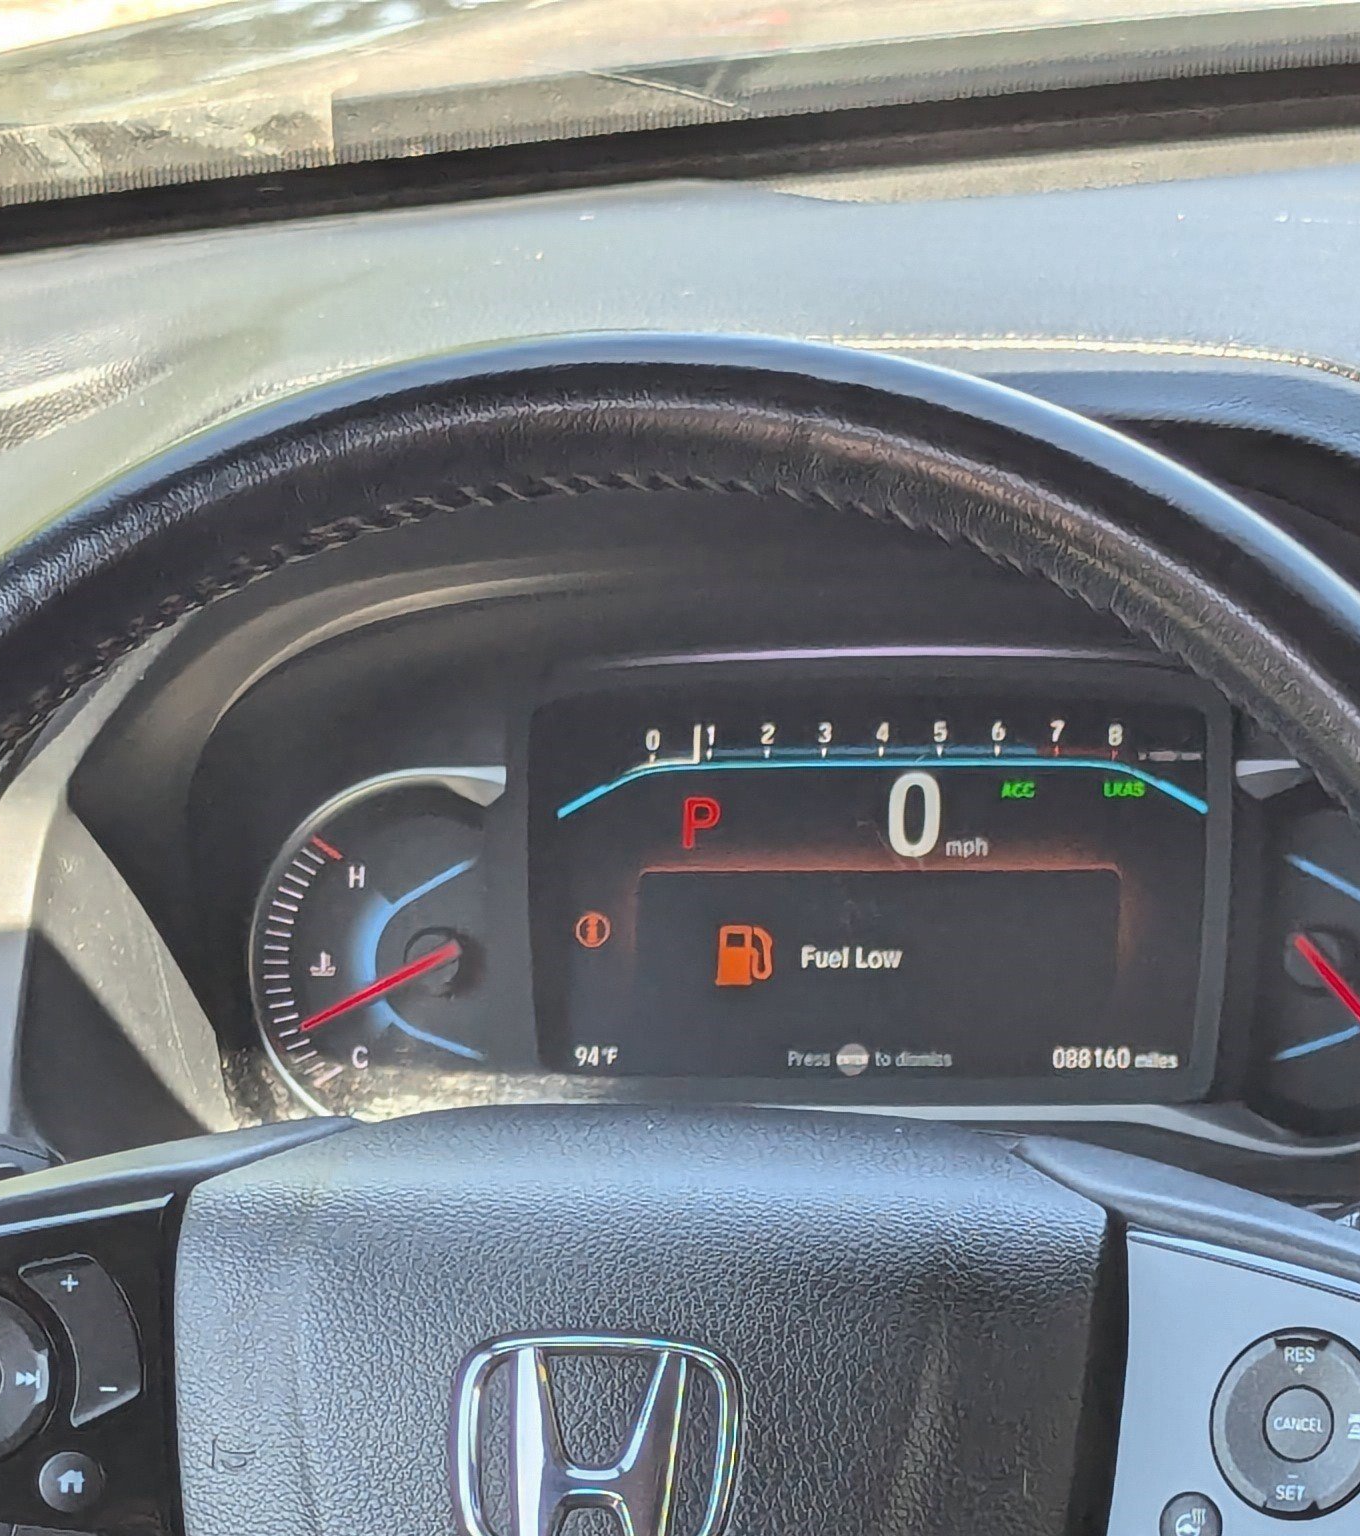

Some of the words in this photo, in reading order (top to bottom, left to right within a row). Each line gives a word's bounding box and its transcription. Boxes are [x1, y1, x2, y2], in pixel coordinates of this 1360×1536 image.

[645, 728, 661, 751] 0
[706, 723, 716, 746] 1
[760, 722, 776, 745] 2
[817, 721, 833, 744] 3
[875, 721, 890, 743] 4
[933, 719, 948, 743] 5
[991, 720, 1007, 742] 6
[1049, 719, 1065, 742] 7
[1107, 723, 1123, 746] 8
[1000, 780, 1036, 799] ACC
[681, 796, 721, 849] P
[888, 771, 941, 858] 0
[945, 836, 989, 859] mph
[348, 865, 366, 889] H
[800, 945, 850, 970] Fuel
[854, 945, 904, 970] Low
[351, 1045, 369, 1069] C
[874, 1051, 891, 1067] to
[1051, 1045, 1131, 1070] 088160
[1283, 1346, 1316, 1364] RES
[1273, 1416, 1323, 1433] CANCEL
[1275, 1484, 1307, 1501] SET
